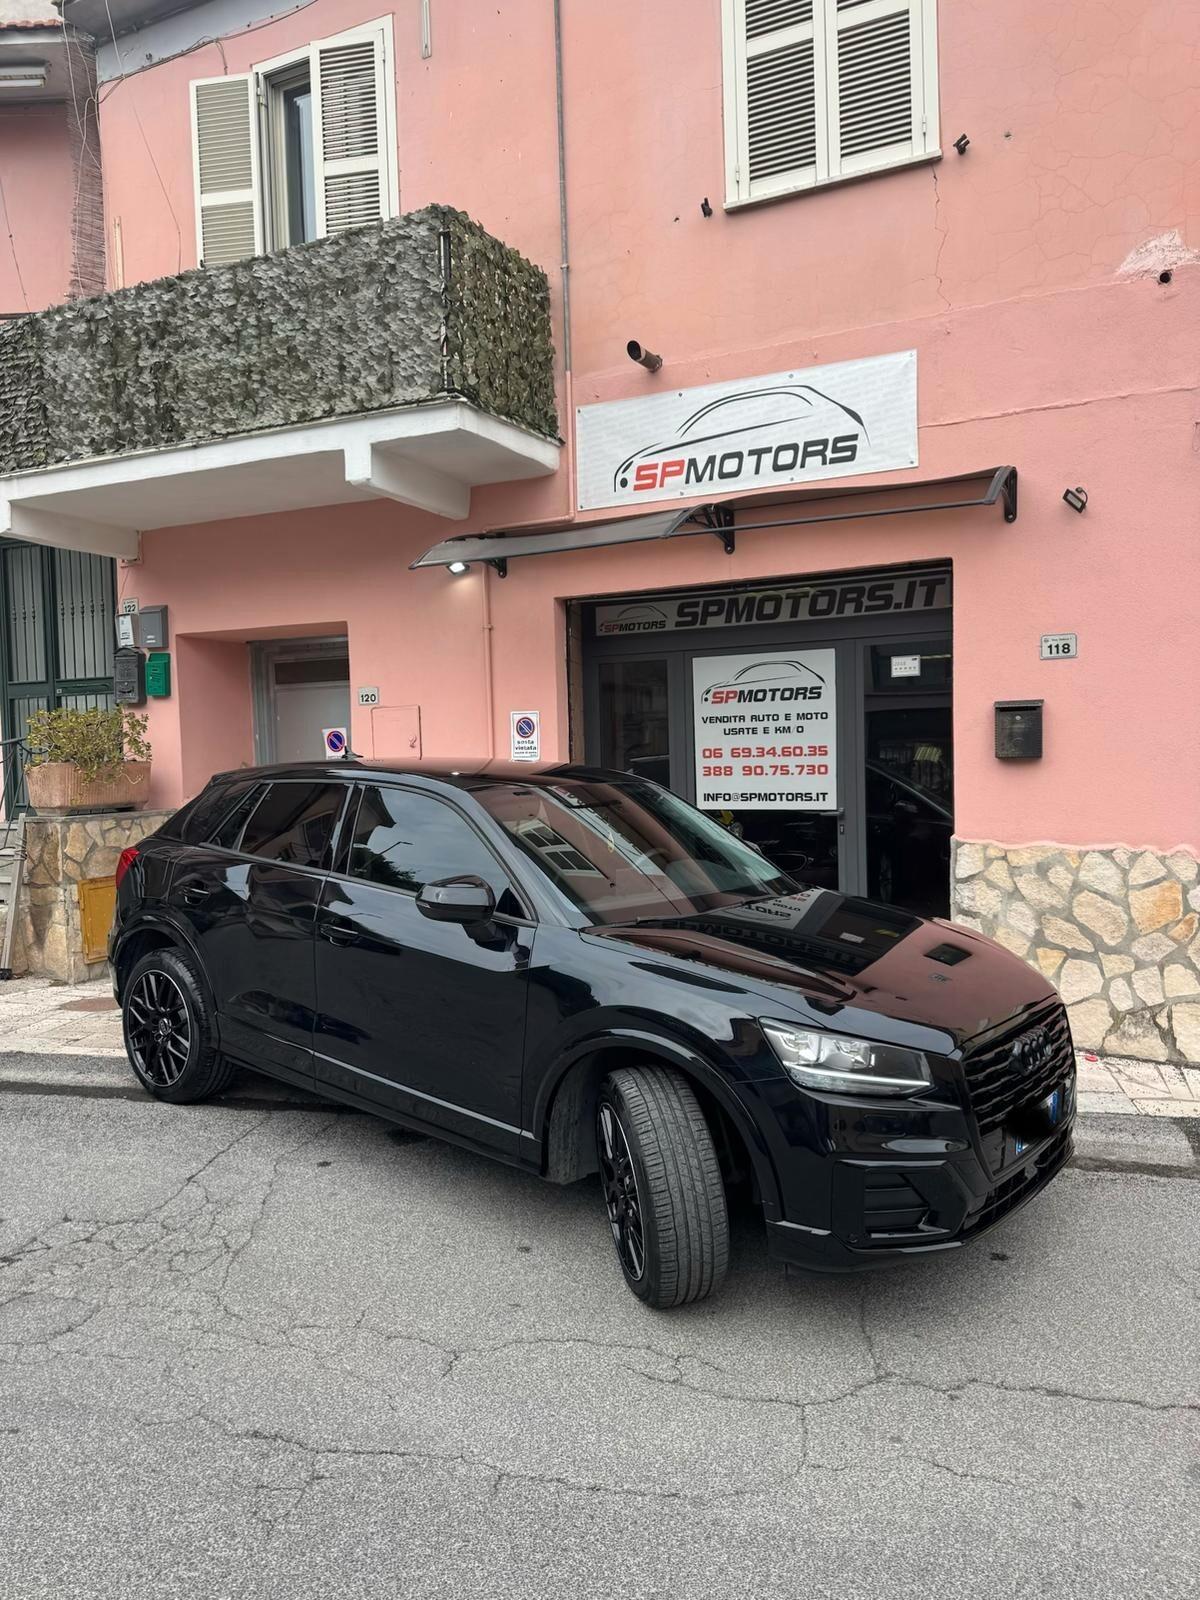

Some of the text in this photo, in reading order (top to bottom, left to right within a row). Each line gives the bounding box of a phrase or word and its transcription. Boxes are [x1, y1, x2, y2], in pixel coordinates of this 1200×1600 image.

[633, 433, 859, 491] SPMOTORS
[124, 604, 136, 613] 122
[674, 577, 946, 628] SPMOTORS.IT
[604, 620, 666, 633] SPMOTORS
[1047, 642, 1071, 655] 118
[360, 693, 376, 703] 120
[711, 686, 823, 704] SPMOTORS
[701, 712, 829, 724] VENDITA AUTO E MOTO
[723, 727, 758, 736] USATE
[763, 726, 770, 735] E
[702, 745, 829, 759] 06 69.34.60.35
[702, 764, 829, 777] 388 90.75.730
[703, 792, 829, 802] INFO@SPMOTORS.IT
